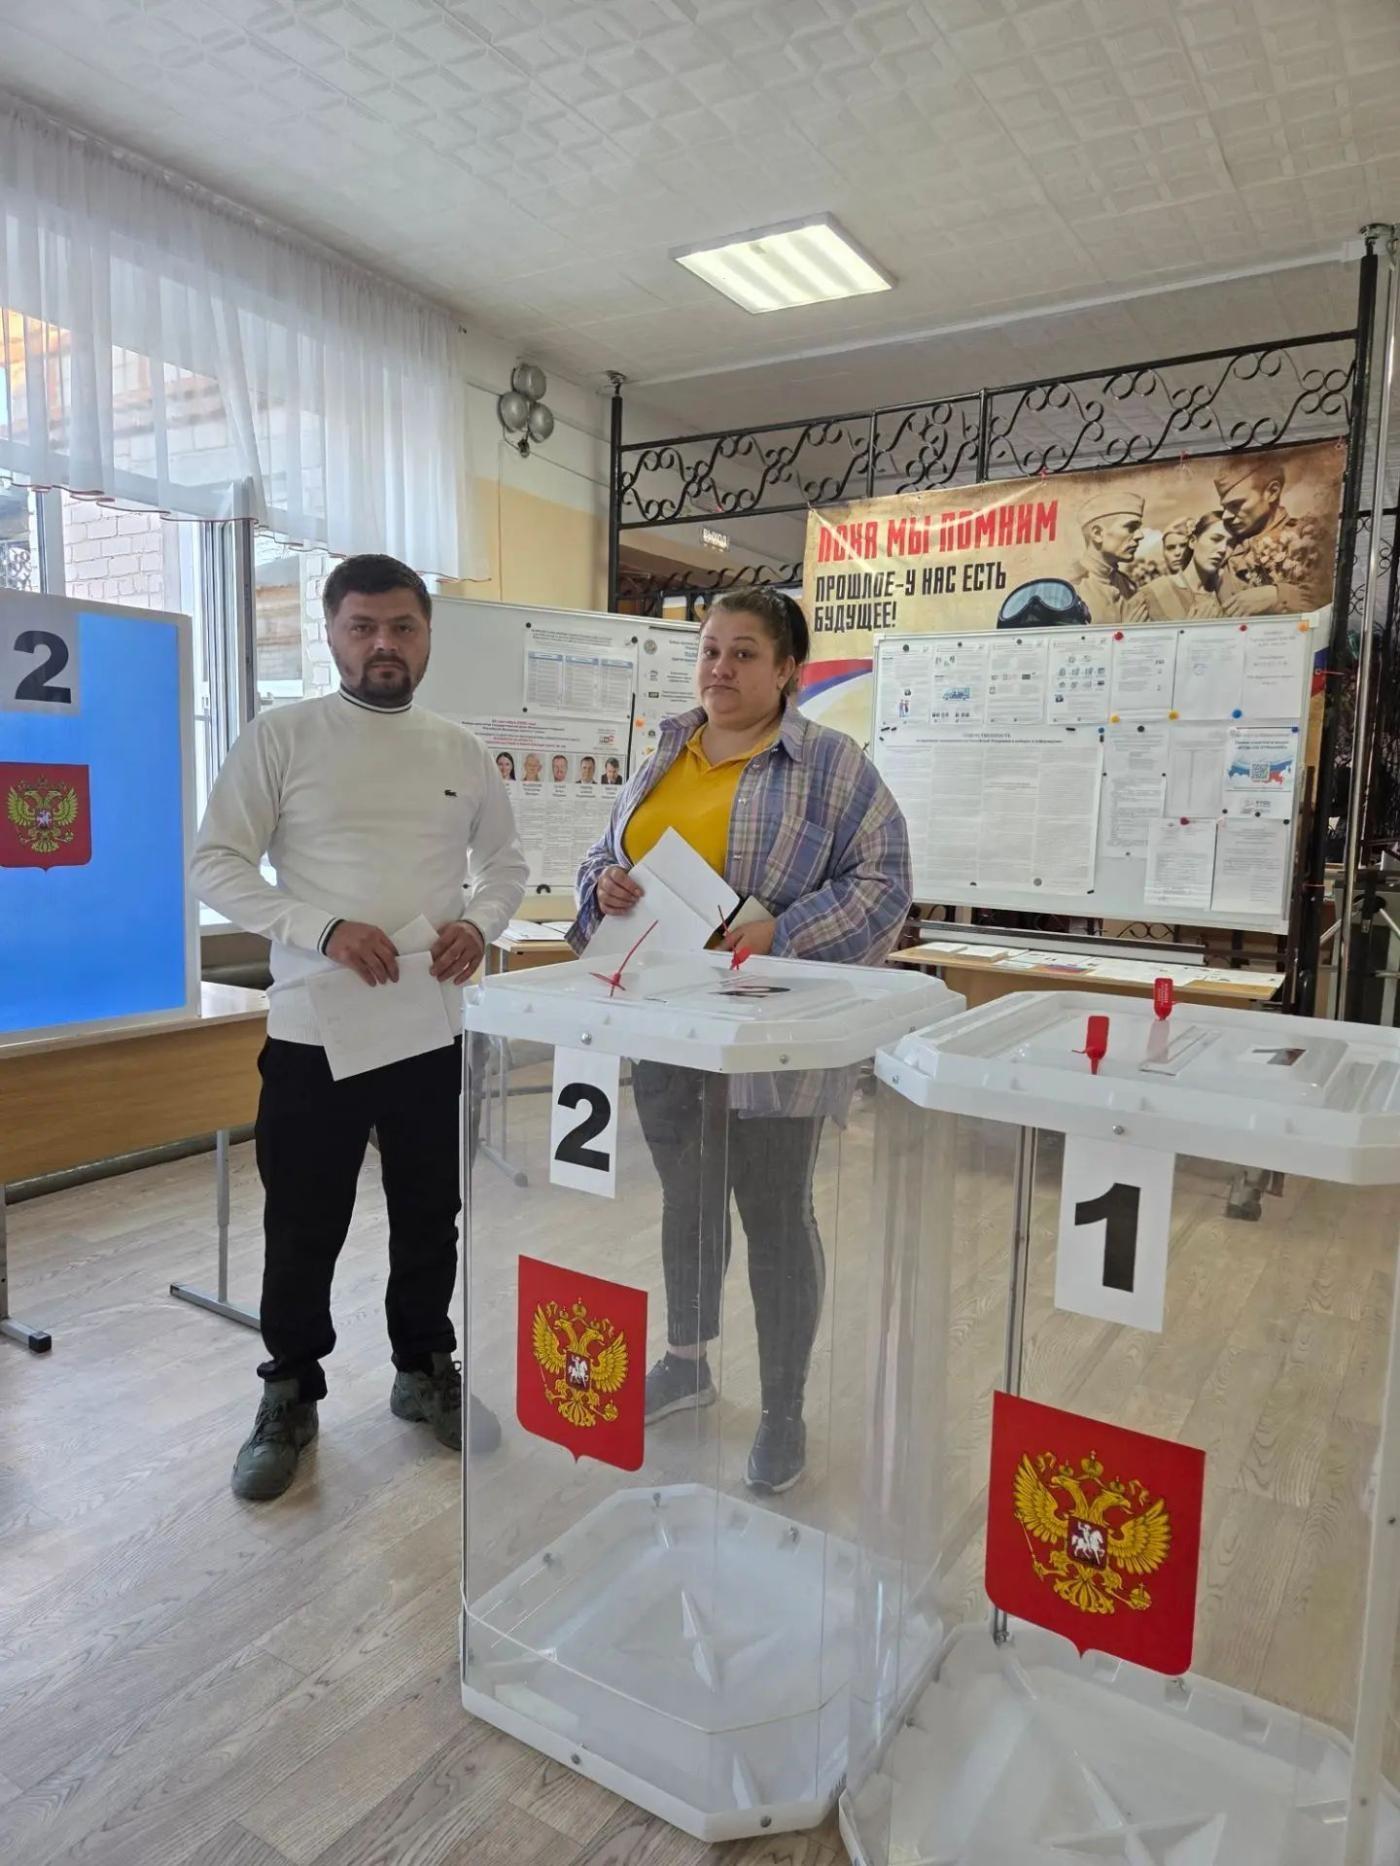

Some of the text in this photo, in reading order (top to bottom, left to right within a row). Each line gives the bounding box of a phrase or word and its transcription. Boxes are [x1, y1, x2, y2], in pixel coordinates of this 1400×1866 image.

[887, 515, 930, 558] МЫ
[939, 499, 1059, 552] ПОМНИМ
[922, 565, 957, 595] НАС
[963, 561, 1006, 592] ЕСТЬ
[814, 601, 898, 633] БУДУЩЕЕ!
[13, 630, 72, 705] 2
[554, 1082, 612, 1173] 2
[1074, 1182, 1141, 1294] 1
